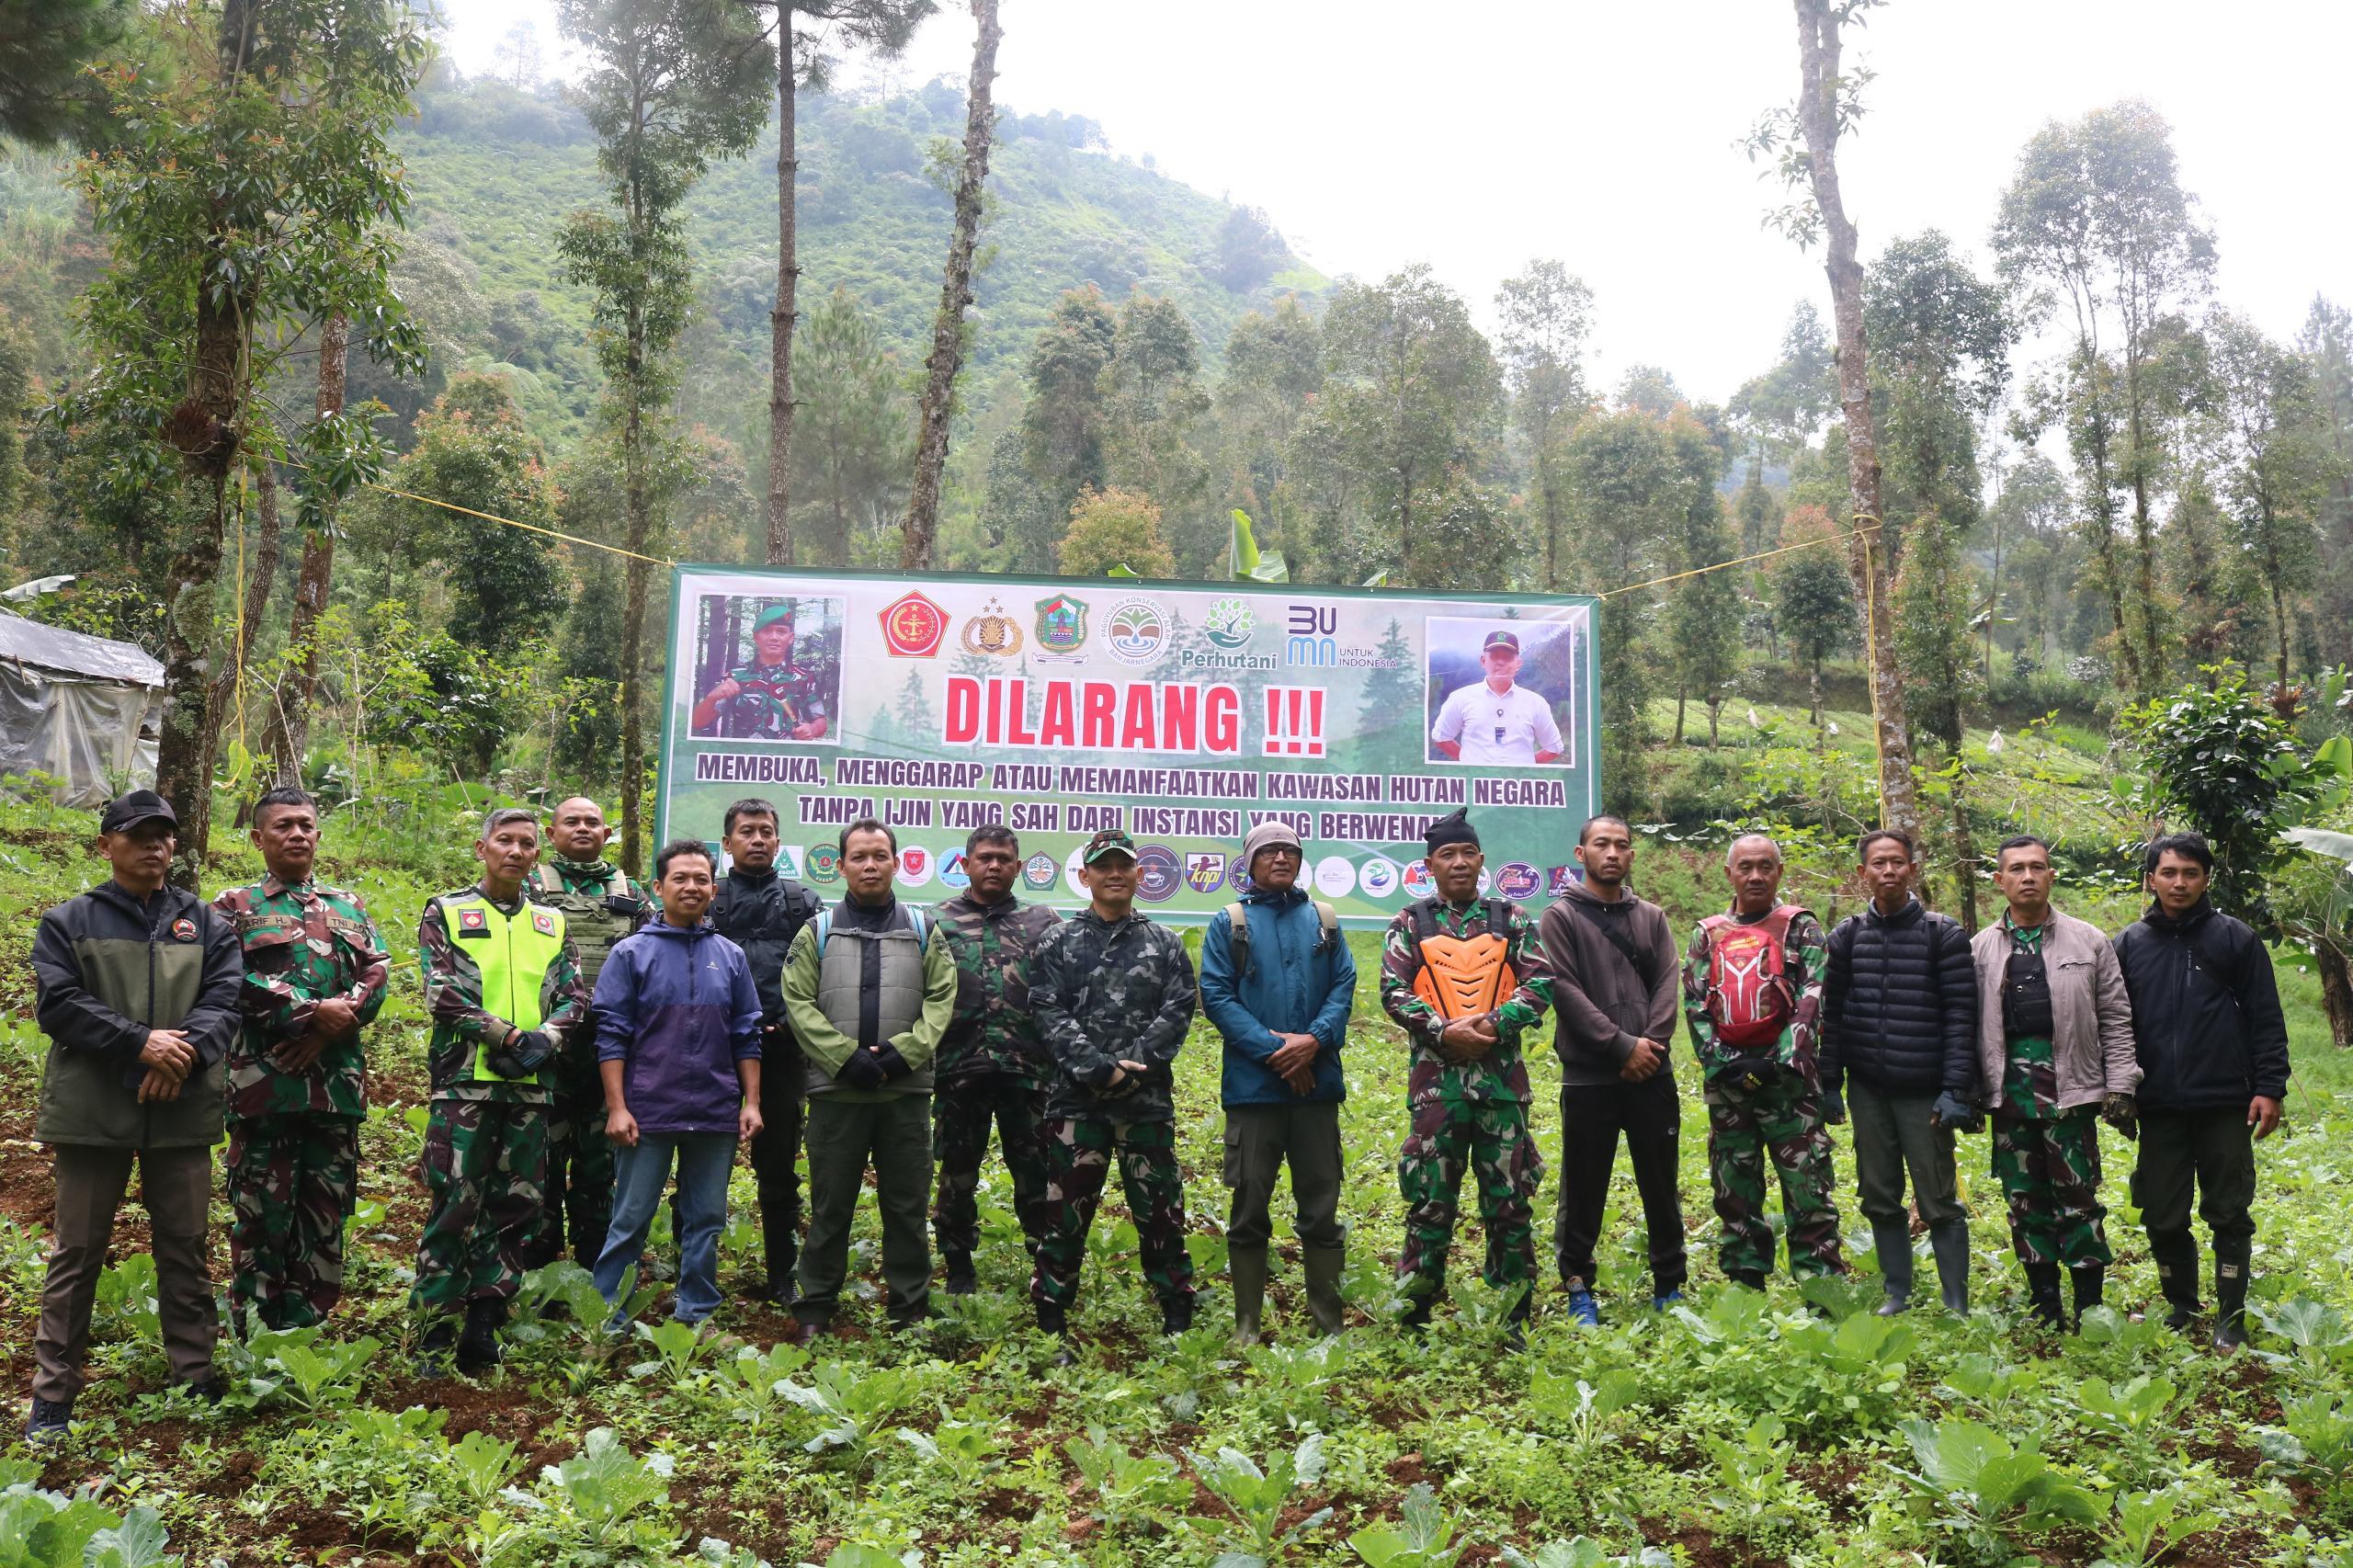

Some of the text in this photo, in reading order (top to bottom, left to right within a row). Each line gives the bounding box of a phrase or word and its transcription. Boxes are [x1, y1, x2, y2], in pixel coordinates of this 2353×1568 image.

[1108, 648, 1163, 665] BANJARNEGARA
[1182, 650, 1278, 669] Perhutani
[1339, 648, 1374, 657] UNTUK
[1339, 658, 1397, 668] INDONESIA
[945, 676, 1324, 755] DILARANG !!!
[697, 754, 1564, 806] MEMBUKA, MENGGARAP ATAU MEMANFAATKAN KAWASAN HUTAN NEGARA
[799, 796, 873, 824] TANPA
[884, 799, 931, 826] IJIN
[940, 801, 1002, 827] YANG
[1011, 803, 1058, 830] SAH
[1067, 805, 1122, 832] DARI
[1132, 807, 1239, 836] INSTANSI
[1320, 813, 1446, 841] BERWENA
[331, 918, 348, 928] TNI
